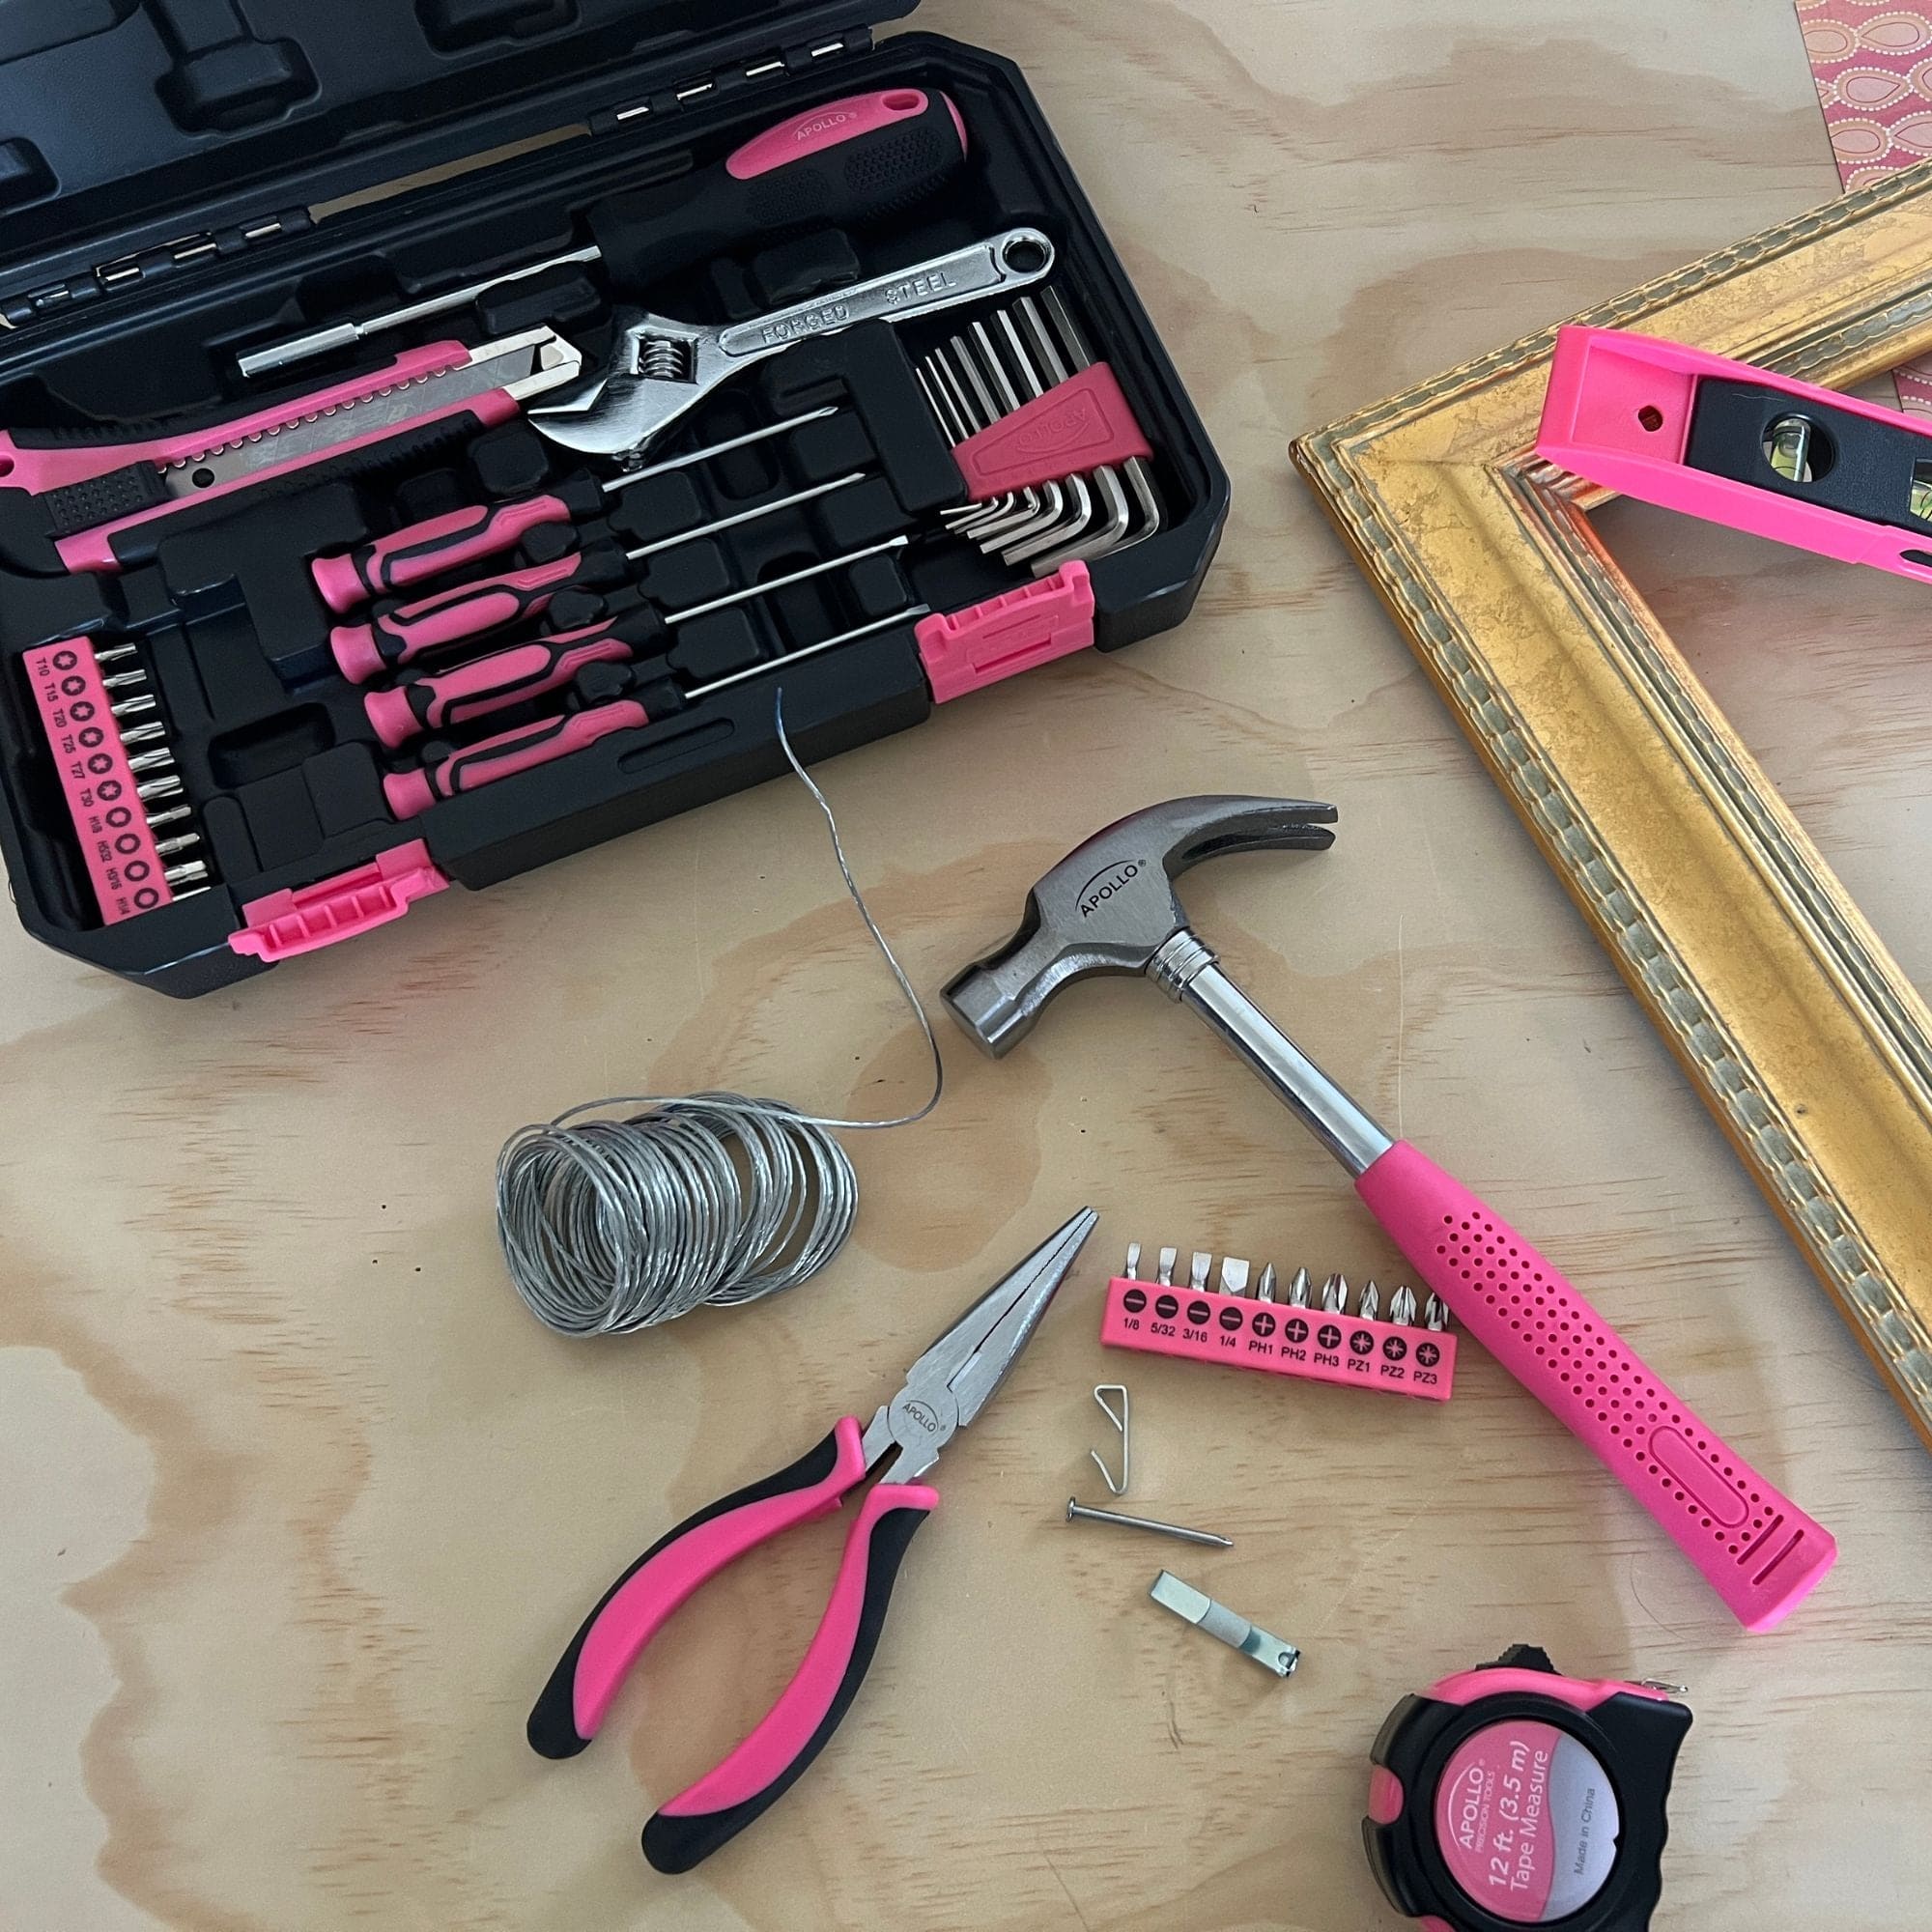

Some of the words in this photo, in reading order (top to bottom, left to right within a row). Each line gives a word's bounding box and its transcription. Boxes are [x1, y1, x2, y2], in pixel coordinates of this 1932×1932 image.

[797, 114, 846, 141] APOLLO
[761, 303, 850, 345] FORGED
[883, 270, 956, 305] STEEL
[36, 657, 50, 676] T10
[44, 682, 59, 702] T15
[52, 708, 68, 728] T20
[61, 734, 76, 754] T25
[71, 760, 86, 780] T27
[79, 787, 95, 808] T30
[1080, 865, 1138, 918] APOLLO
[1122, 1318, 1140, 1331] 1/8
[1151, 1322, 1177, 1338] 5/32
[1182, 1327, 1208, 1344] 3/16
[1219, 1335, 1236, 1349] 1/4
[1248, 1341, 1273, 1355] PH1
[1281, 1347, 1306, 1362] PH2
[1314, 1351, 1340, 1368] PH3
[1348, 1358, 1371, 1374] PZ1
[1380, 1364, 1406, 1379] PZ2
[1413, 1370, 1437, 1385] PZ3
[902, 1403, 936, 1433] APOLLO
[1509, 1740, 1530, 1772] m)
[1483, 1771, 1495, 1801] TOOLS
[1499, 1776, 1521, 1822] (3.5
[1520, 1749, 1548, 1837] Measure
[1459, 1766, 1484, 1851] APOLLO
[1581, 1787, 1596, 1823] China
[1492, 1830, 1514, 1852] ft.
[1581, 1826, 1590, 1839] in
[1489, 1858, 1510, 1886] 12
[1510, 1842, 1534, 1891] Tape
[1574, 1842, 1588, 1876] Made
